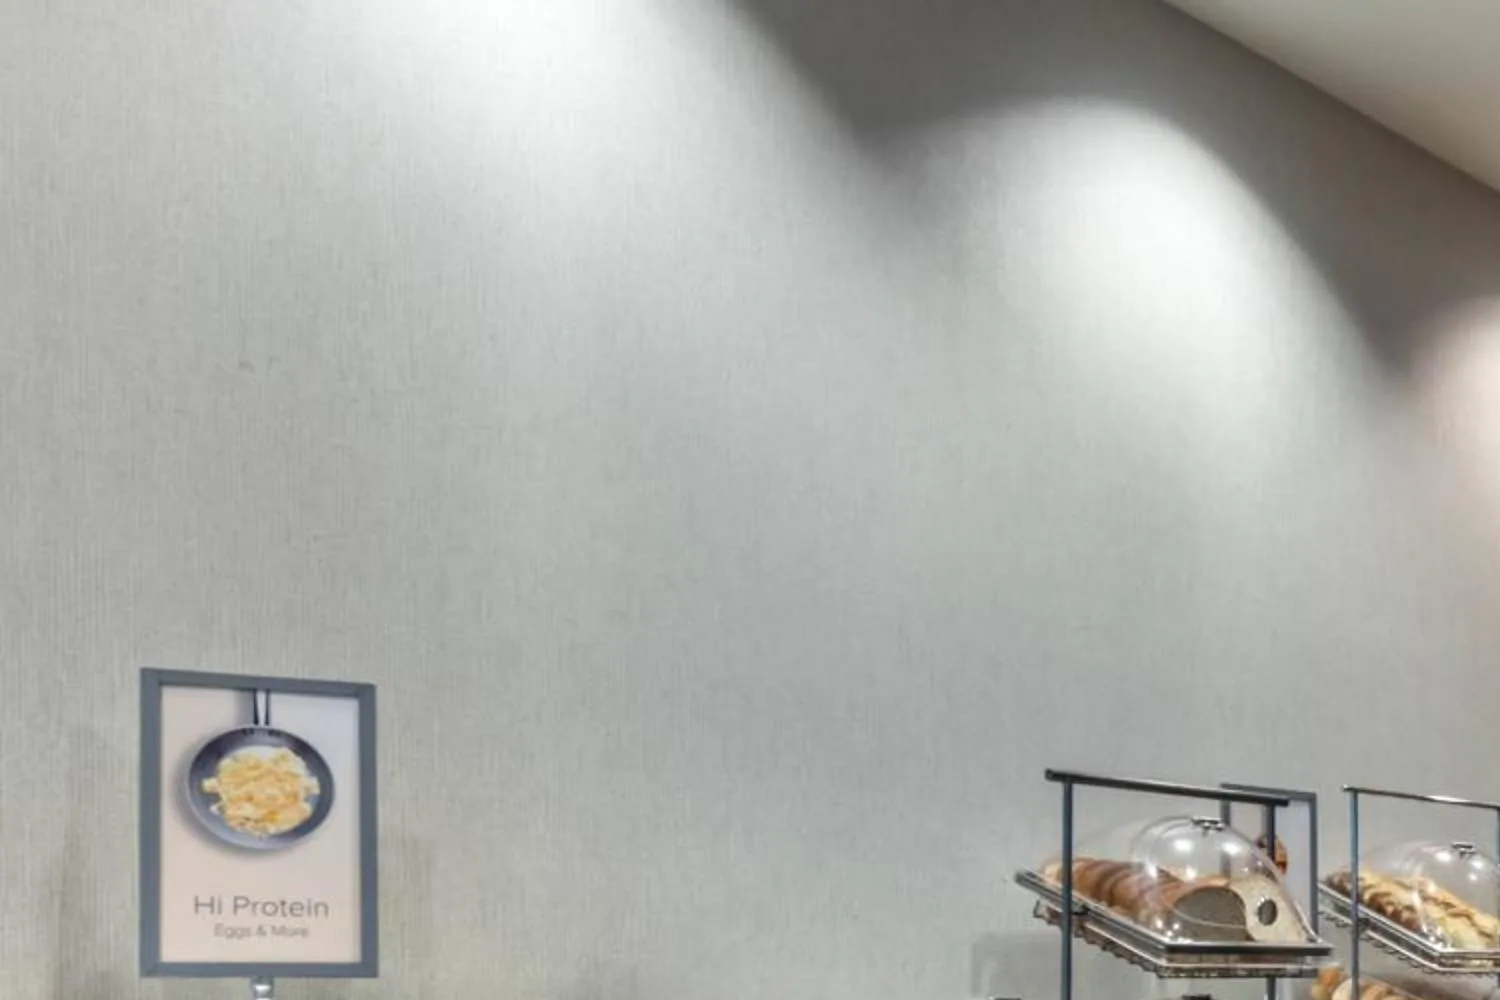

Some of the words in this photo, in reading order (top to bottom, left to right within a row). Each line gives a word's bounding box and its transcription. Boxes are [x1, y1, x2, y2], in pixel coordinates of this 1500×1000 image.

[194, 895, 222, 915] Hi
[233, 895, 330, 918] Protein
[214, 922, 251, 939] Eggs
